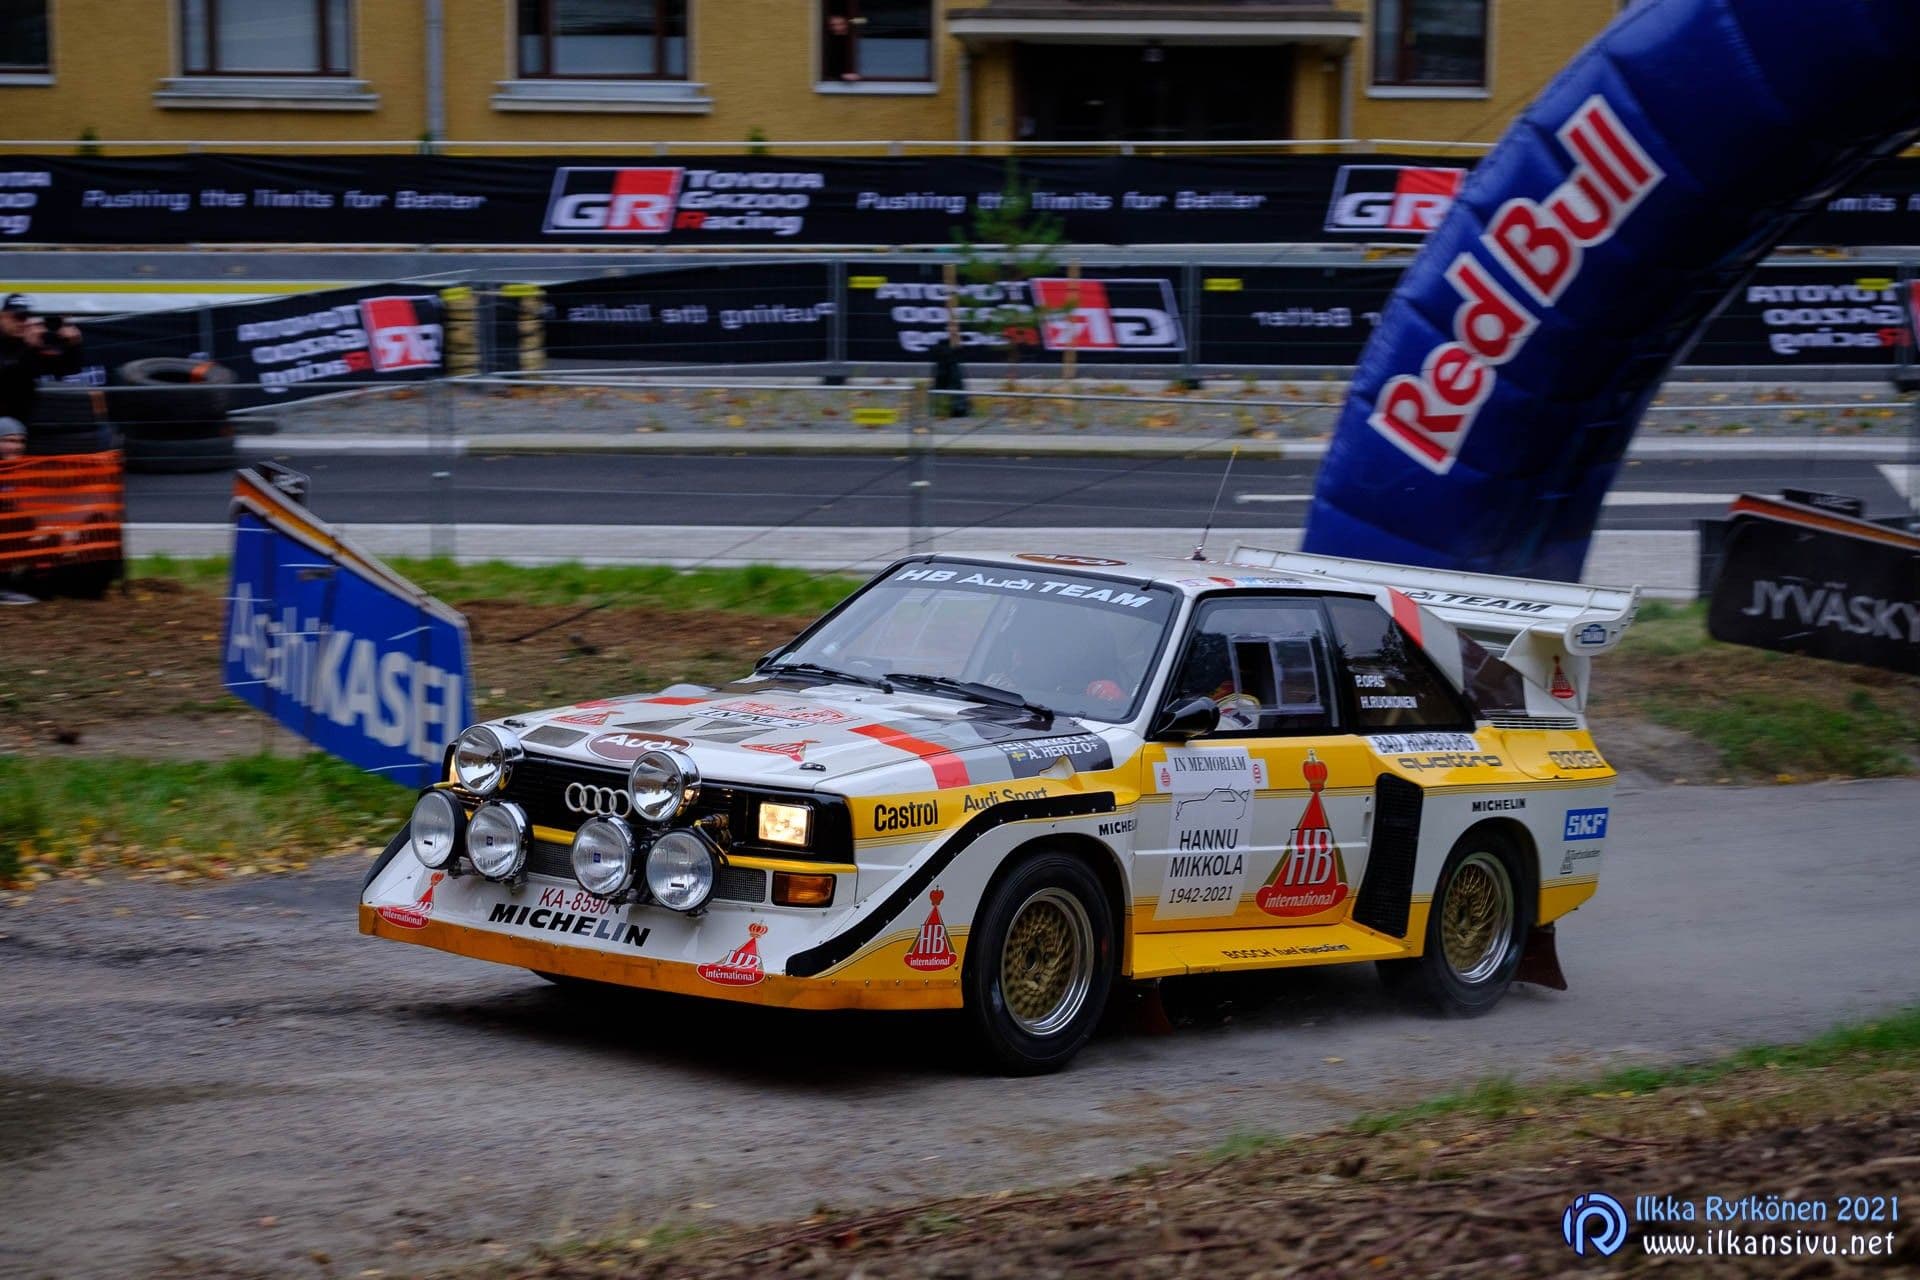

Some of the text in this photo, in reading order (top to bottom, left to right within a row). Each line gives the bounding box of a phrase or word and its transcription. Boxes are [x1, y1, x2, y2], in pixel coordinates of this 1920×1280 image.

[82, 189, 488, 211] Pushing the limits for Better
[552, 193, 672, 228] GR
[856, 191, 966, 214] Pushing
[1032, 191, 1114, 210] limits
[1121, 191, 1168, 209] for
[1174, 191, 1268, 209] Better
[1369, 94, 1665, 475] Red Bull
[896, 569, 958, 582] HB
[1038, 581, 1154, 608] TEAM
[1441, 593, 1553, 613] TEAM
[1042, 743, 1081, 758] HERTZ
[1173, 756, 1247, 772] IN MEMORIAM
[1397, 754, 1503, 773] quattro
[963, 790, 999, 813] Audi
[1471, 798, 1527, 813] MICHELIN
[874, 799, 939, 832] Castrol
[1566, 813, 1607, 837] SKF
[1179, 828, 1239, 851] HANNU
[1169, 854, 1244, 878] MIKKOLA
[1284, 828, 1336, 887] HB
[1168, 885, 1233, 904] 1942-2021
[1264, 889, 1336, 908] international
[488, 903, 651, 947] MICHELIN
[920, 923, 946, 954] HB
[910, 955, 951, 967] international
[705, 968, 755, 982] international
